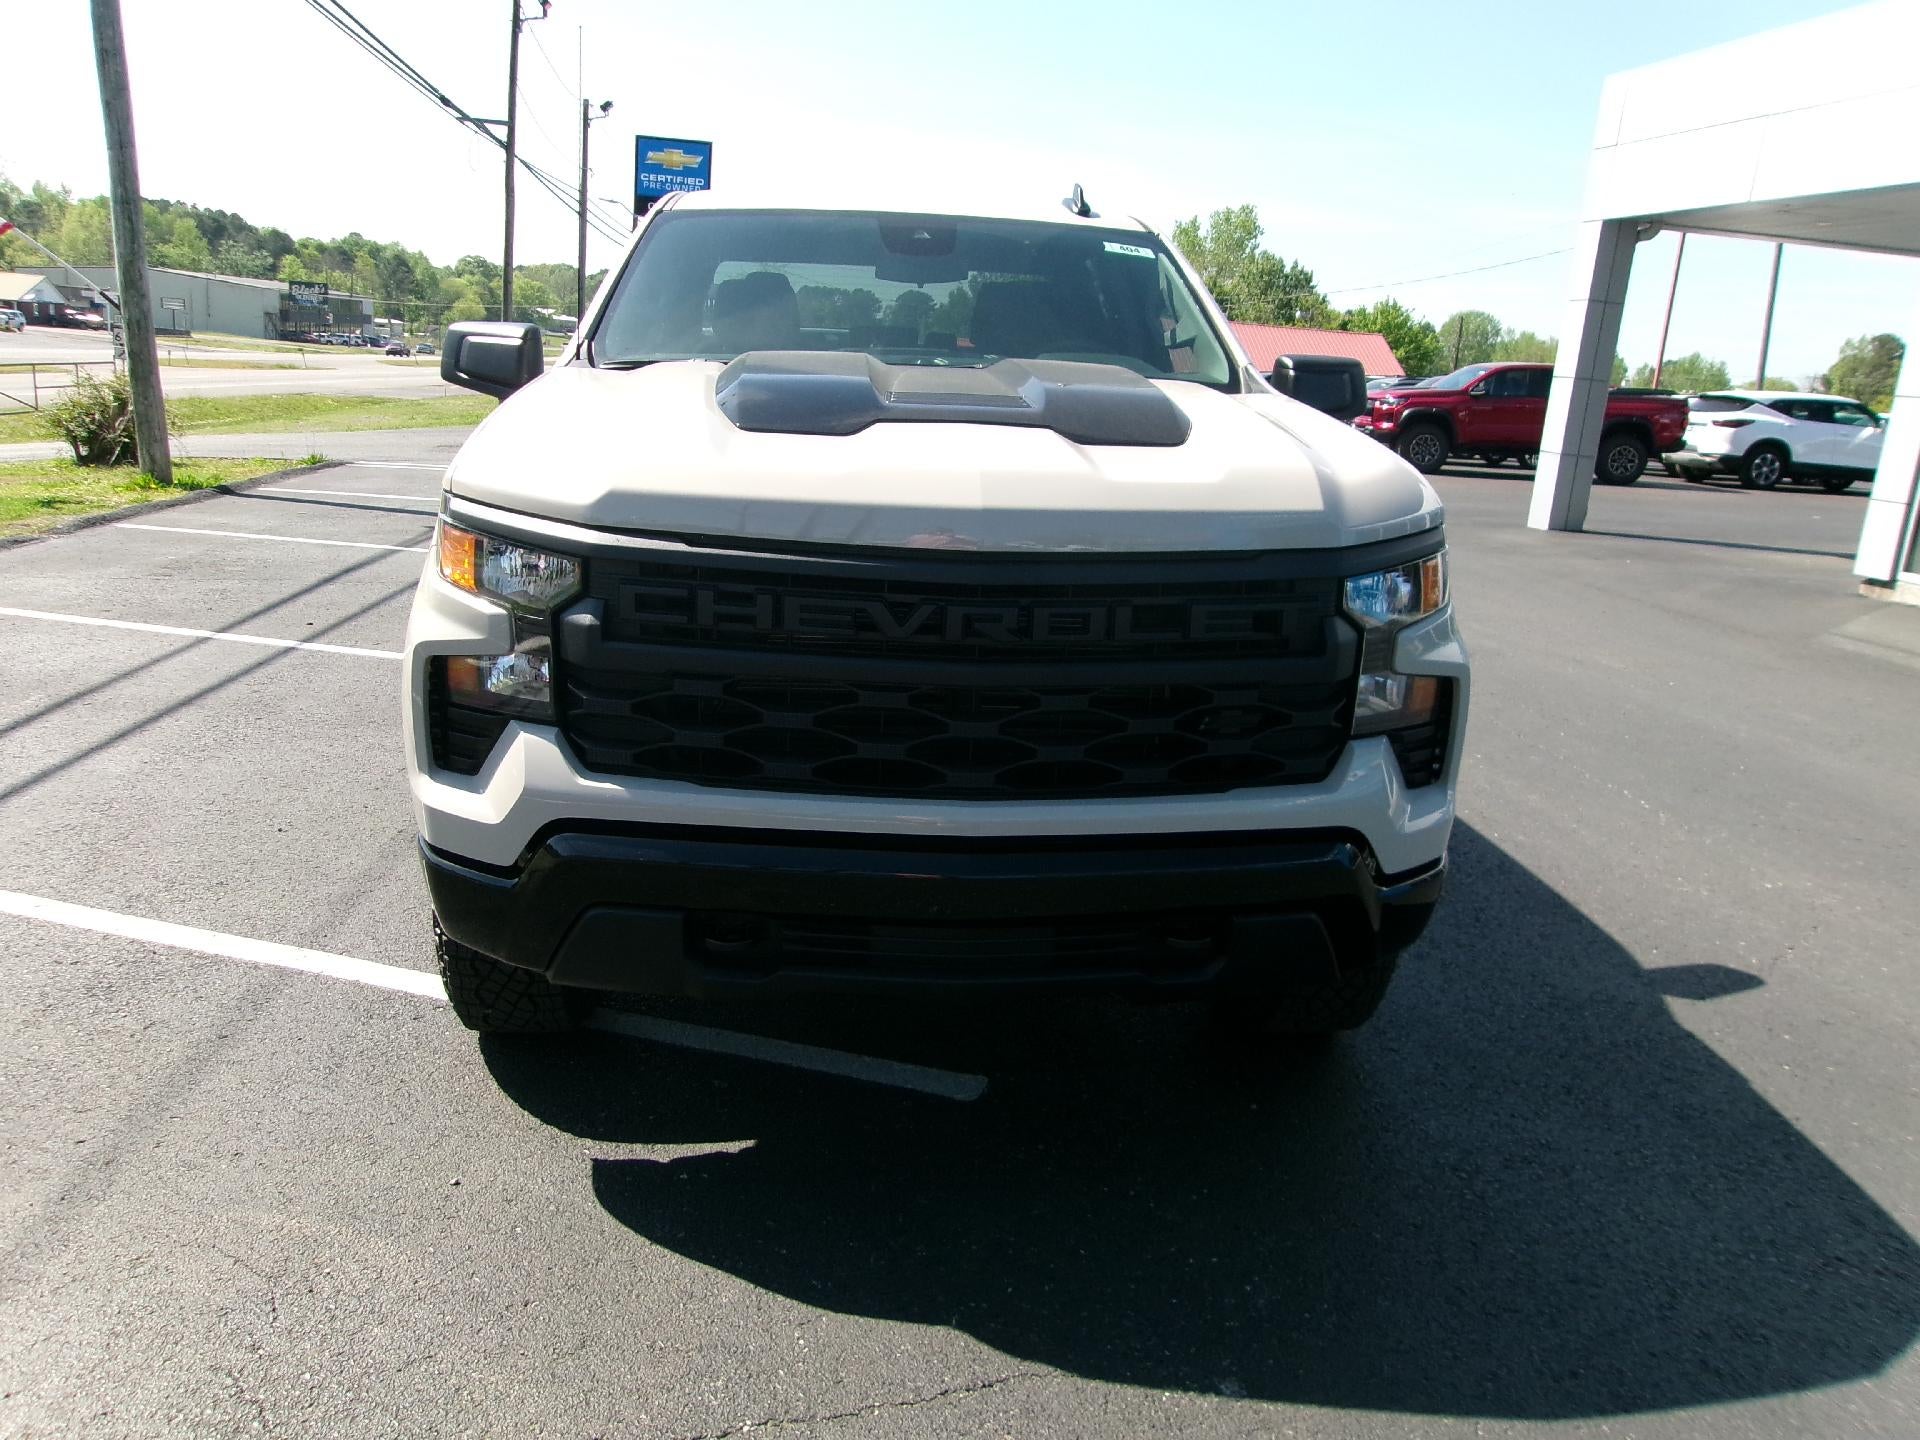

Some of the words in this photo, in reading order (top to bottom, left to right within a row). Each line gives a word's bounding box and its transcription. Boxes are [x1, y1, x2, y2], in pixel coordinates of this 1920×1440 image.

[640, 172, 705, 186] CERTIFIED
[643, 180, 701, 192] PRE-OWNED
[617, 581, 1321, 643] CHEVROLET
